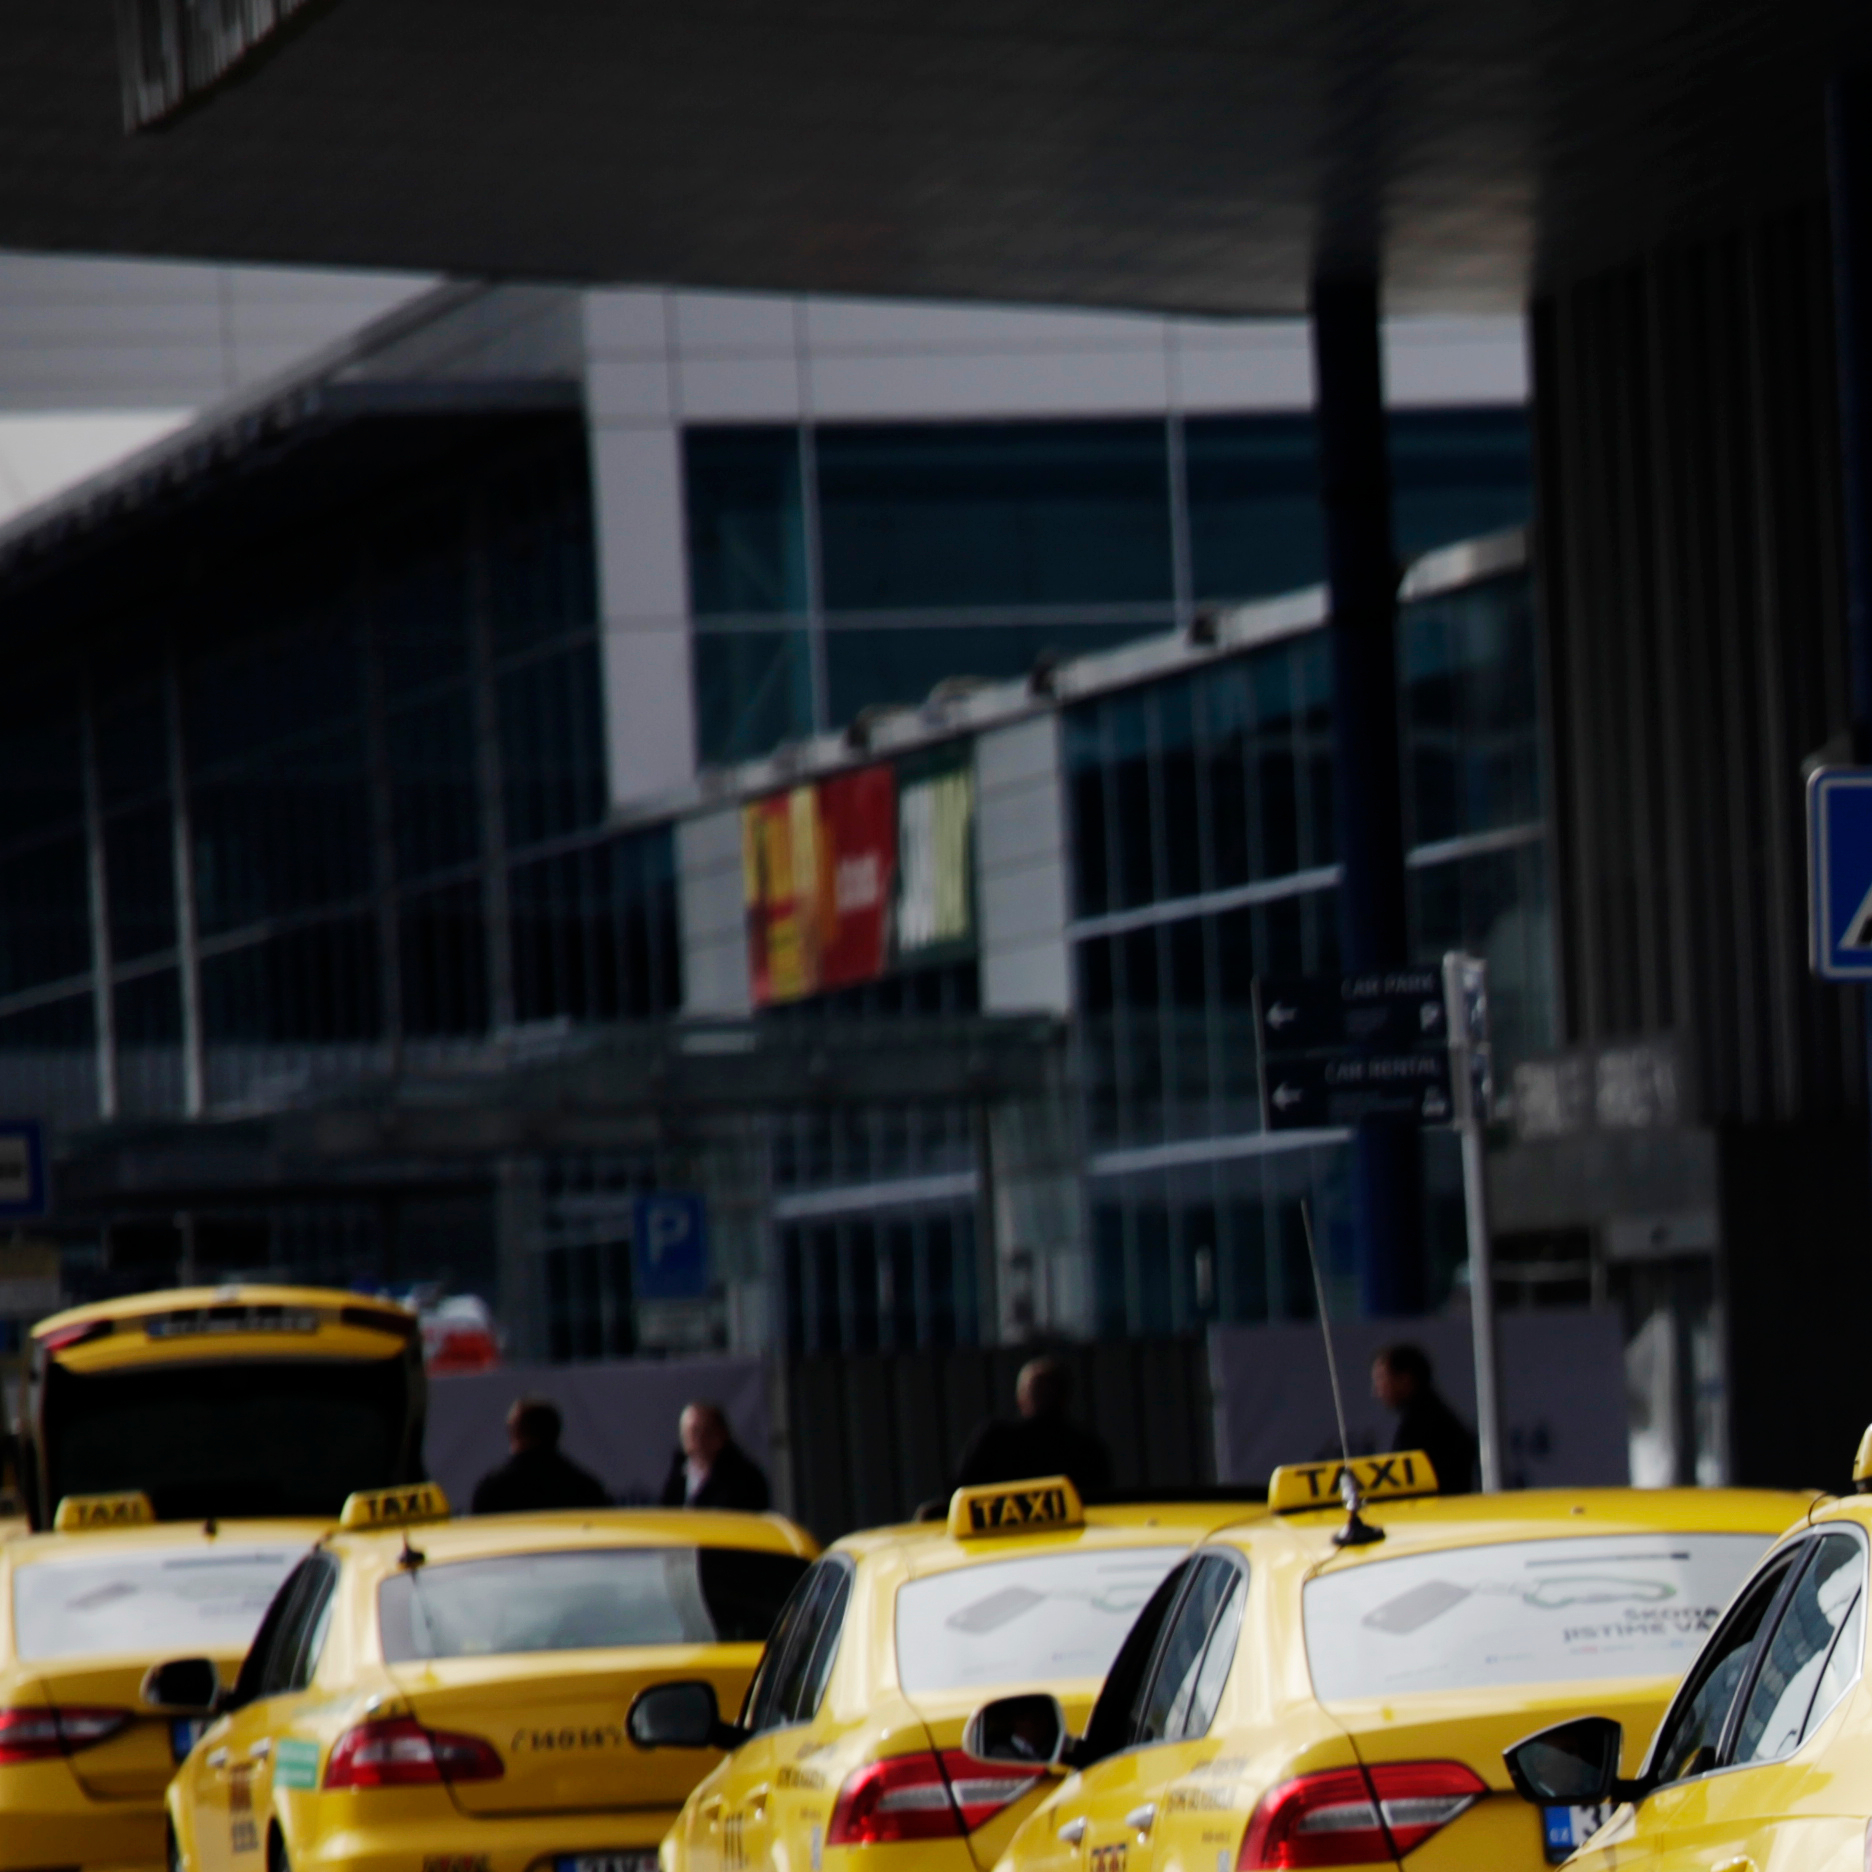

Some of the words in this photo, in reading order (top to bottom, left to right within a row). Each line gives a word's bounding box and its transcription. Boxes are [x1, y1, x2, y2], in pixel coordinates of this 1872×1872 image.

[1295, 1456, 1416, 1497] TAXI
[367, 1491, 434, 1521] TAXI
[976, 1490, 1065, 1527] TAXI
